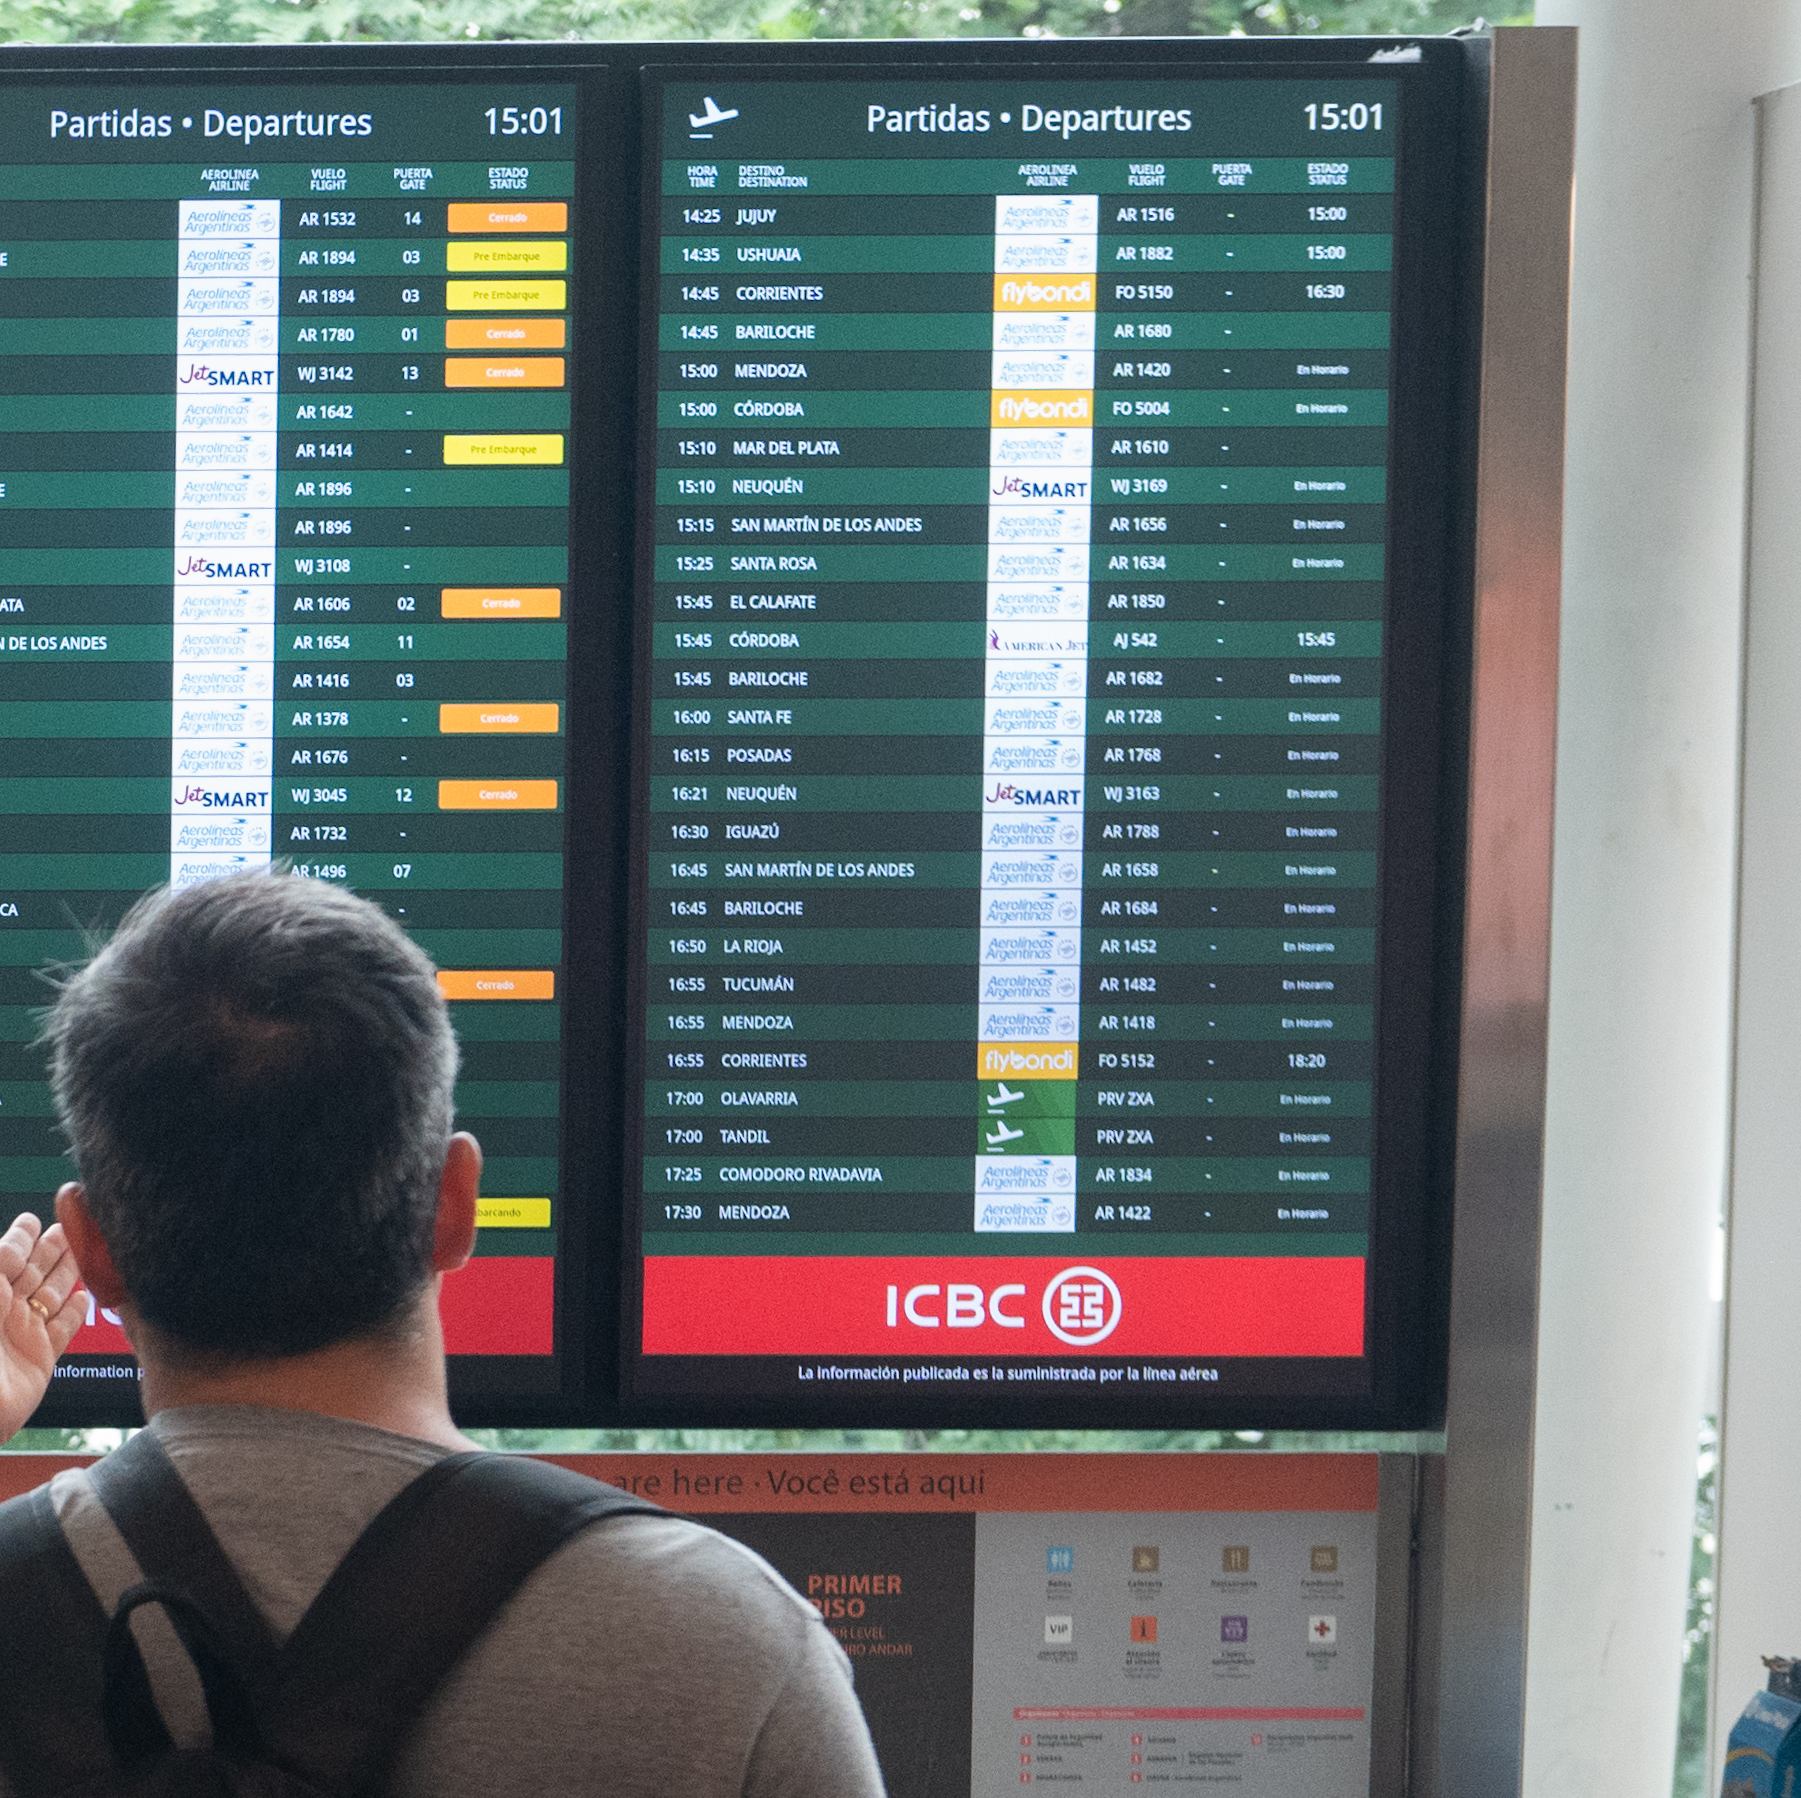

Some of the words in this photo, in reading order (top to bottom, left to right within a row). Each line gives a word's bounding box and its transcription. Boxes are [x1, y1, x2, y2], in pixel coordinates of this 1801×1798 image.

[50, 108, 172, 138] Partidas
[204, 109, 372, 145] Departures
[484, 107, 561, 135] 15:01
[867, 103, 991, 133] Partidas
[1021, 104, 1192, 140] Departures
[1304, 102, 1382, 131] 15:01
[299, 212, 320, 226] AR
[322, 211, 356, 226] 1532
[404, 211, 422, 226] 14
[488, 212, 528, 223] Cerrado
[298, 250, 319, 265] AR
[322, 250, 356, 265] 1894
[402, 250, 421, 265] 03
[473, 251, 490, 262] Pre
[675, 633, 713, 648] 15:45
[729, 630, 800, 648] CÓRDOBA
[1113, 632, 1130, 650] AJ
[1131, 632, 1158, 648] 542
[1297, 632, 1336, 647] 15:45
[886, 1284, 1026, 1328] ICBC
[613, 1474, 660, 1495] are
[673, 1467, 744, 1496] here
[766, 1468, 840, 1496] Você
[849, 1467, 910, 1495] está
[919, 1468, 985, 1502] aqui
[808, 1574, 902, 1595] PRIMER
